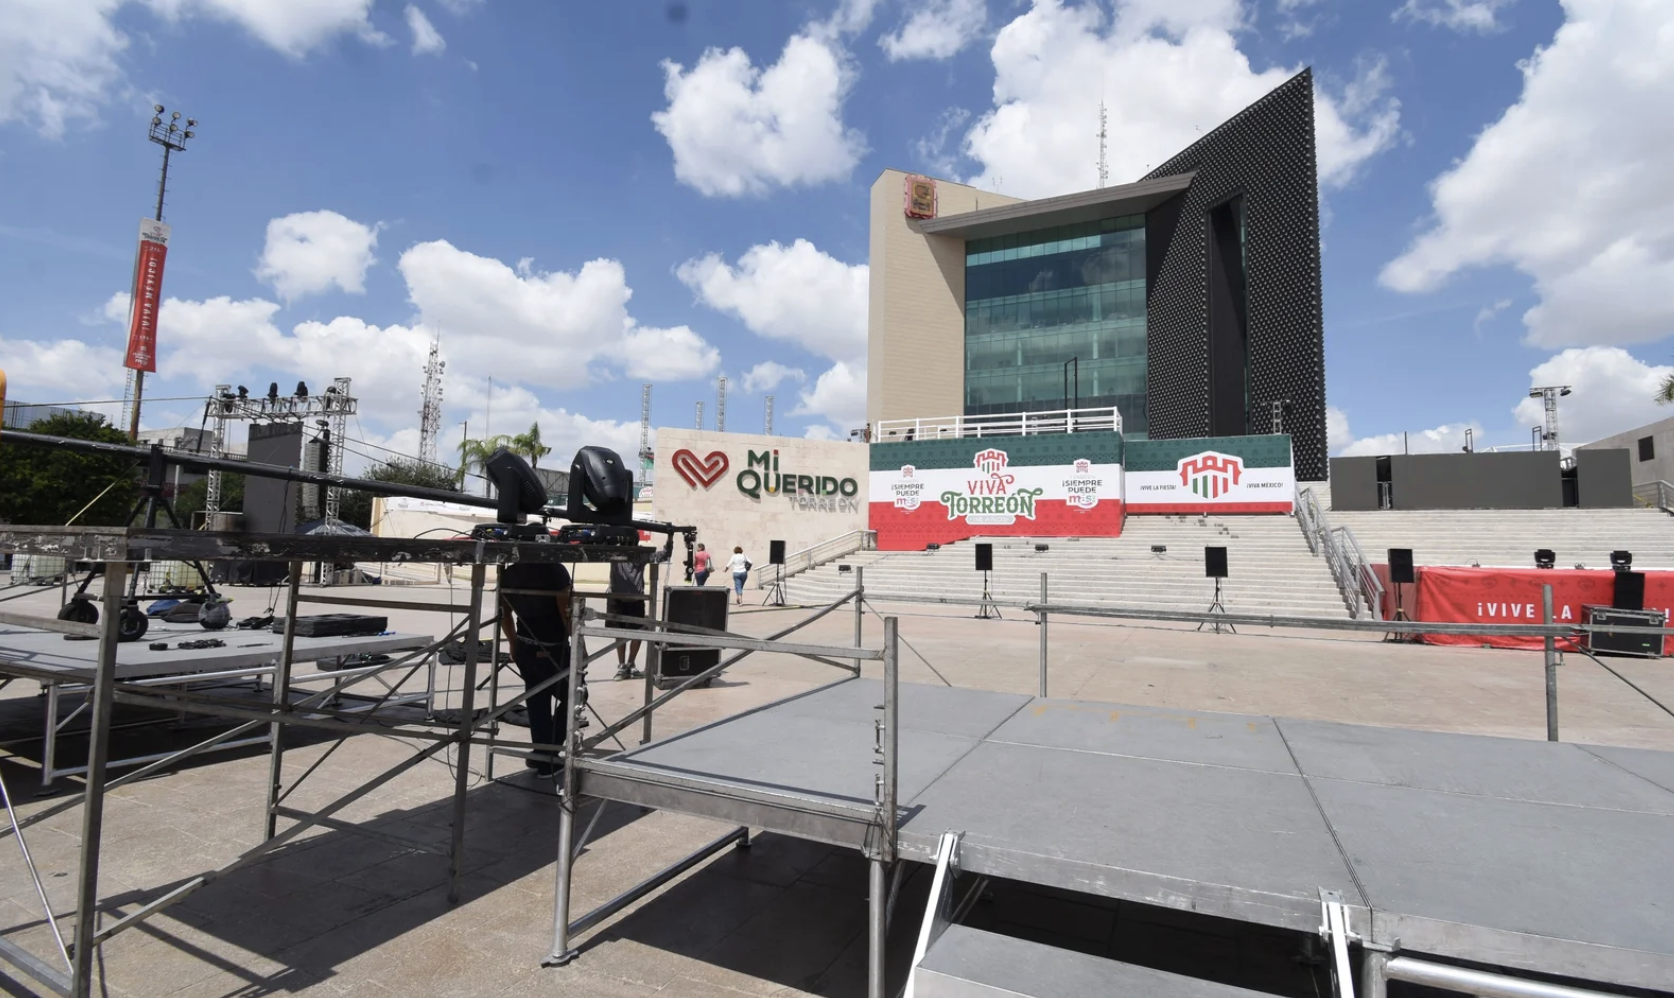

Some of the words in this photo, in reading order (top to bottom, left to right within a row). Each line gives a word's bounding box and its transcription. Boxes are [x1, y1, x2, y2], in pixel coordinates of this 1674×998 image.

[736, 469, 859, 499] QUERIDO
[967, 472, 1015, 495] VIVA
[940, 487, 1044, 518] TORREÓN
[1477, 602, 1535, 618] ¡VIVE
[1552, 604, 1572, 620] A
